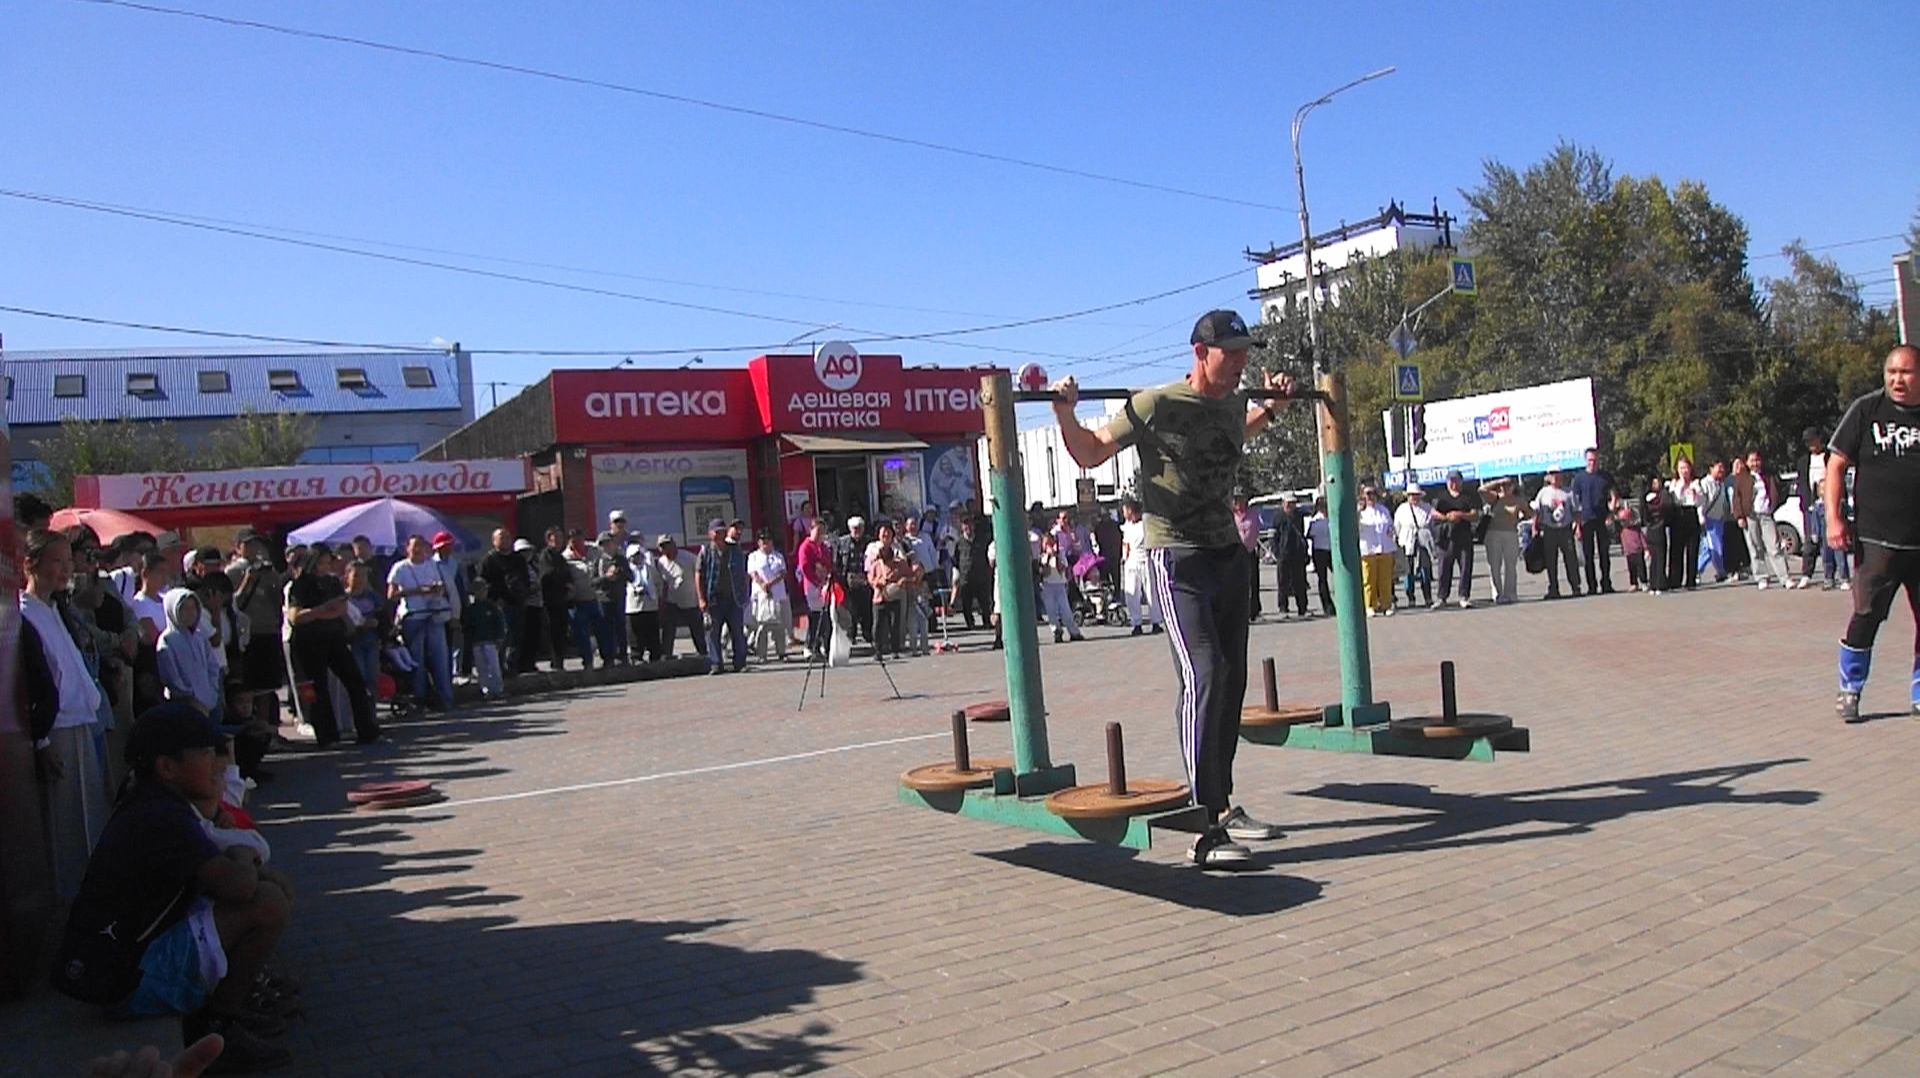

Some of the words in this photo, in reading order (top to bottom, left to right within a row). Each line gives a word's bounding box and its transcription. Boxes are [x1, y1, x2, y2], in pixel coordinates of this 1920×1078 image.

[823, 355, 857, 379] да
[585, 390, 727, 418] аптека
[788, 391, 891, 412] дешевая
[904, 388, 984, 412] птек
[802, 411, 880, 428] аптека
[1491, 412, 1508, 427] 20
[1462, 430, 1475, 445] 18
[1873, 422, 1920, 452] LEGE
[136, 474, 326, 507] Женская
[339, 463, 492, 495] одежда
